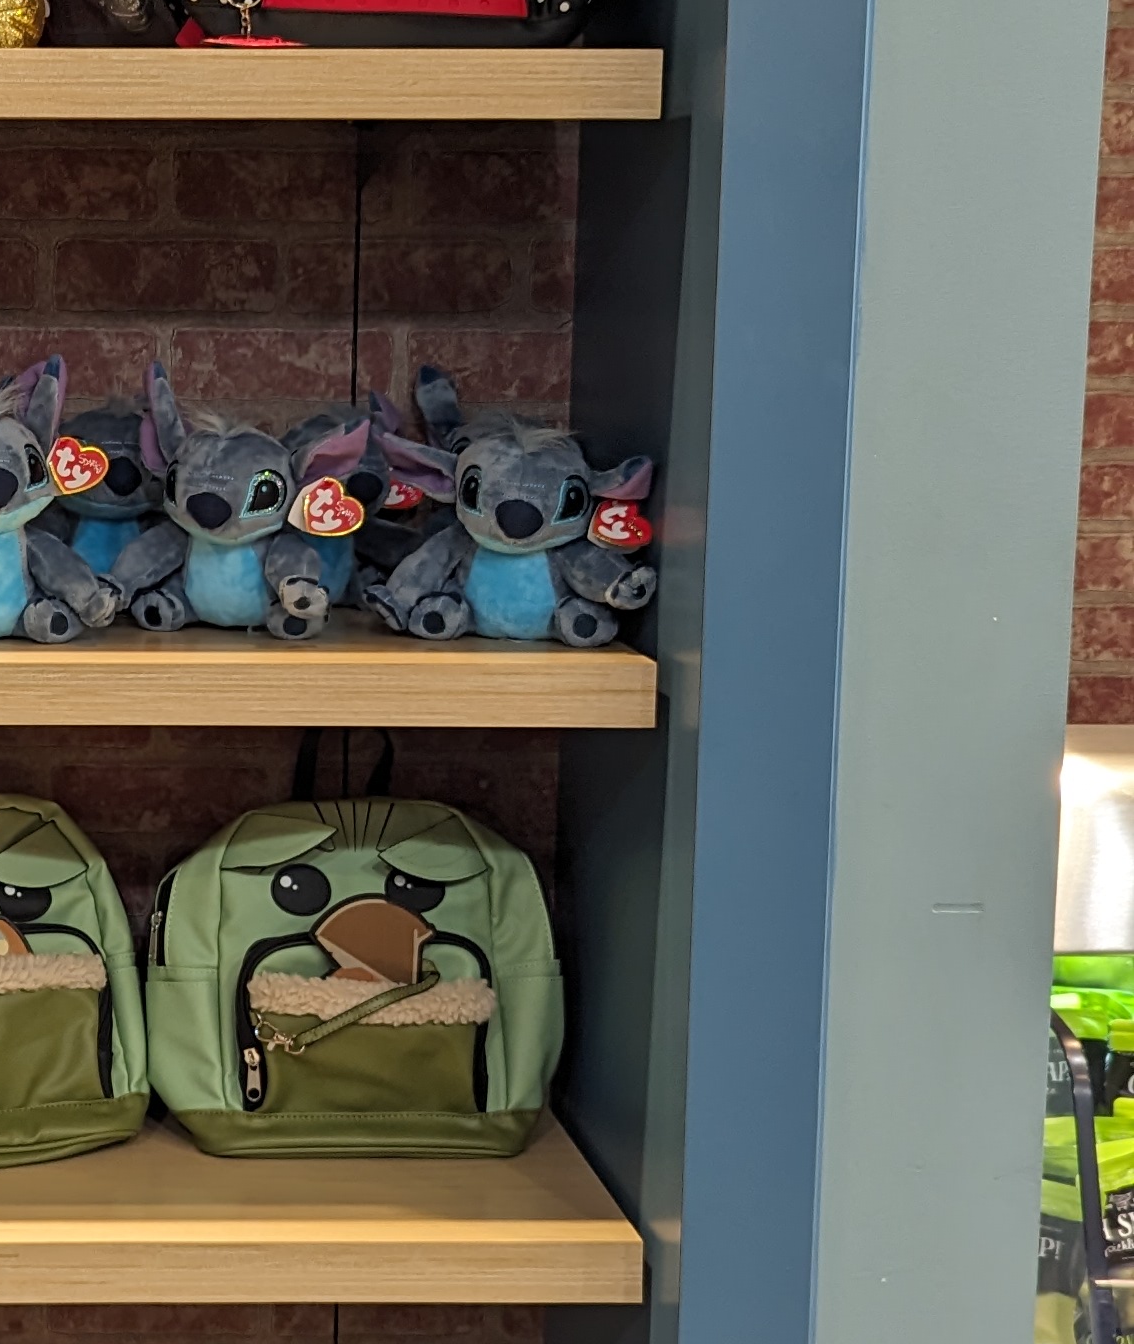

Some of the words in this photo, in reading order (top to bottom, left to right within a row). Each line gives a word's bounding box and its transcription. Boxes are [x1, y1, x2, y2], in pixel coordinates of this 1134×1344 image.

[56, 447, 92, 488] ty
[310, 488, 343, 532] ty
[597, 500, 631, 540] ty
